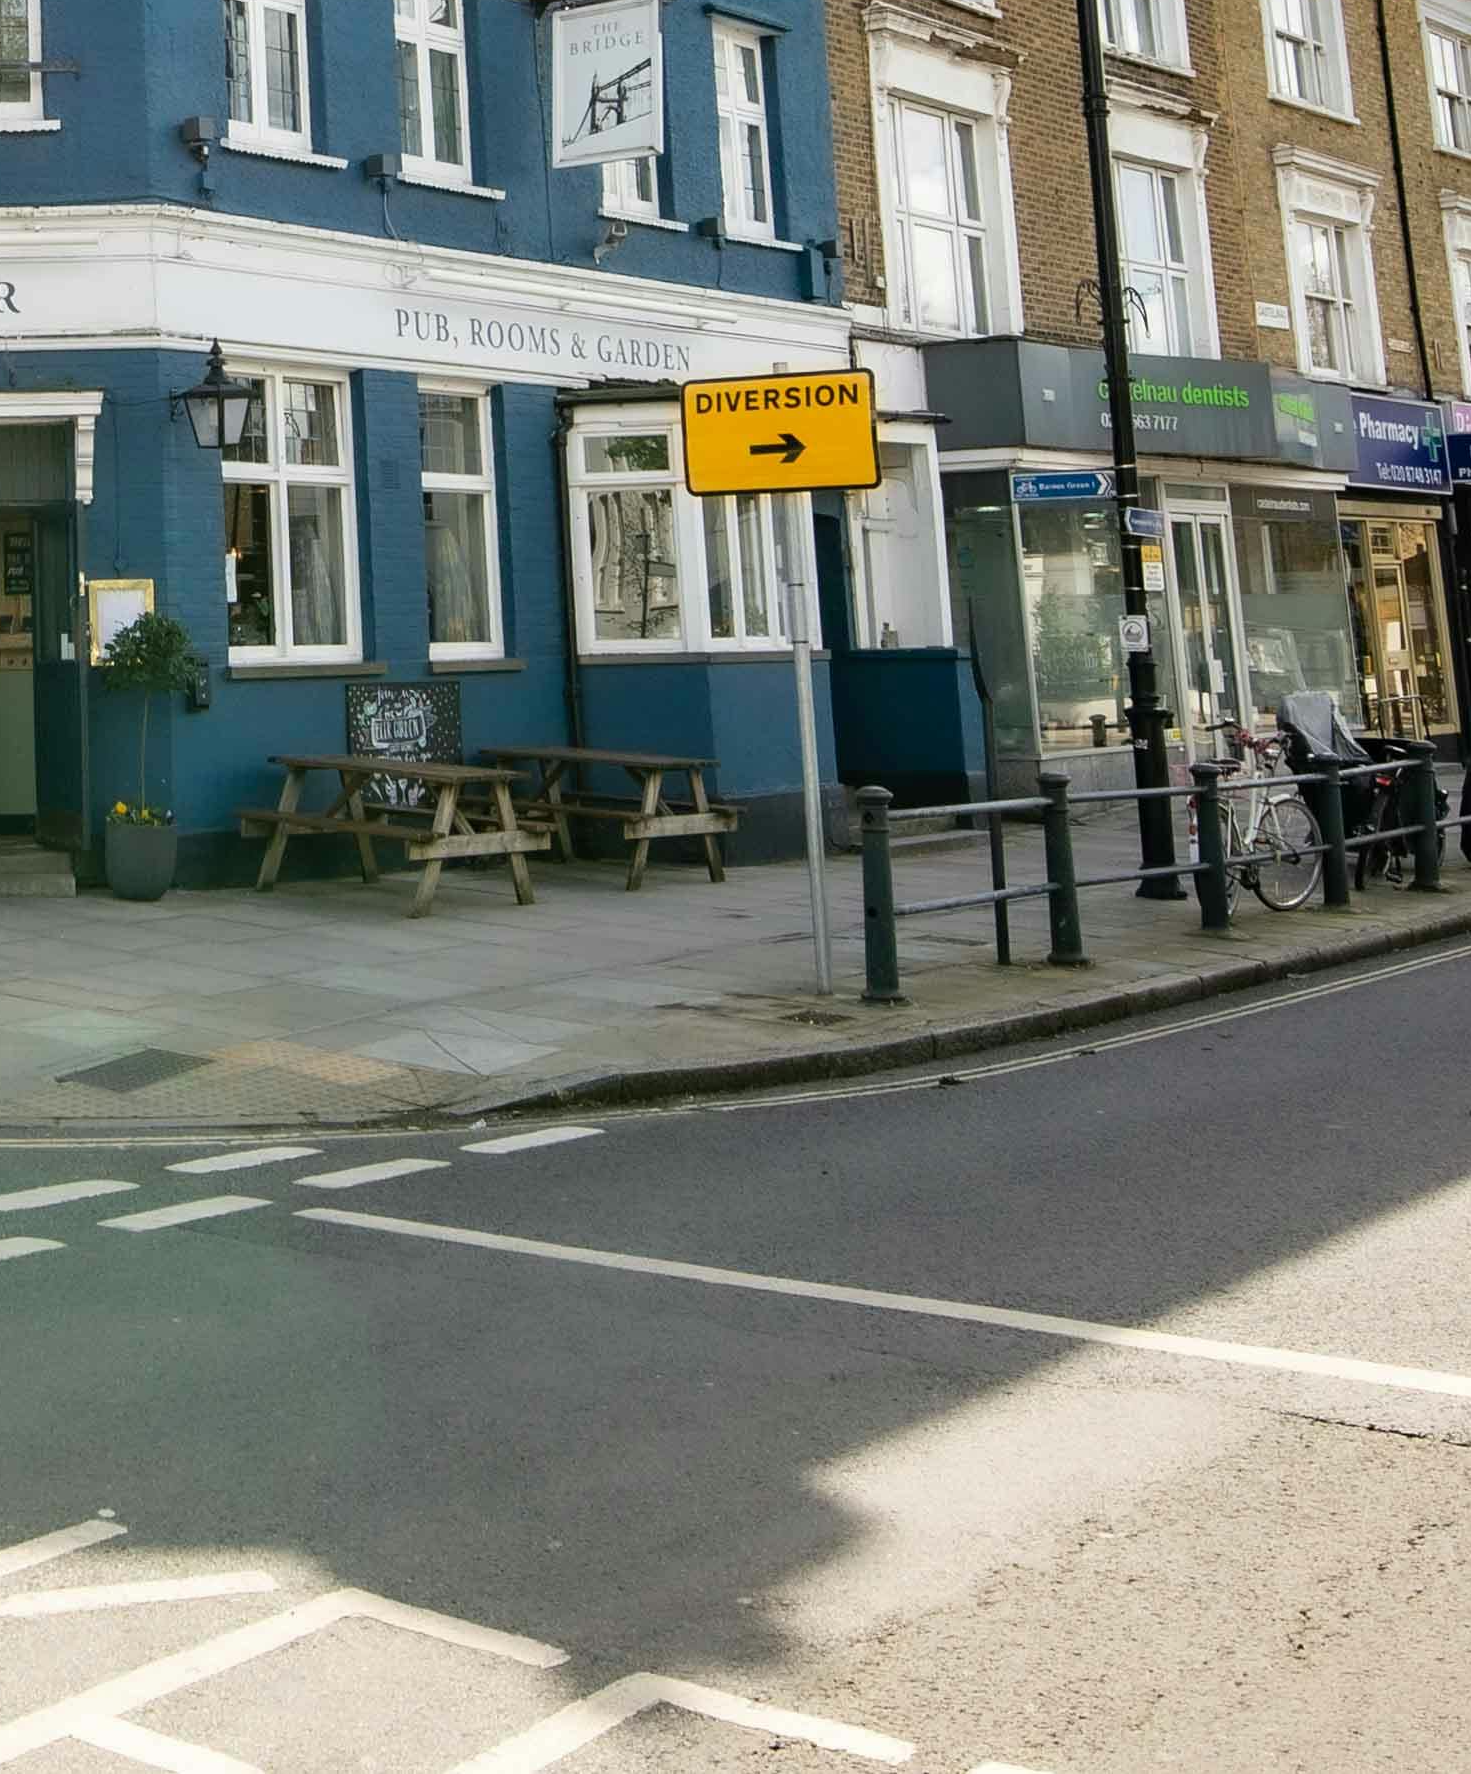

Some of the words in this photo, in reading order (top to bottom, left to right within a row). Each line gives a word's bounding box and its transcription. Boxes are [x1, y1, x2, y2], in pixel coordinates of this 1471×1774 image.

[569, 31, 644, 56] BRIDGE
[394, 307, 459, 348] PUB,
[469, 317, 561, 356] ROOMS
[570, 331, 589, 360] &
[597, 334, 691, 372] GARDEN
[695, 383, 859, 415] DIVERSION
[1182, 378, 1250, 408] dentists
[1359, 412, 1420, 450] Pharmacy
